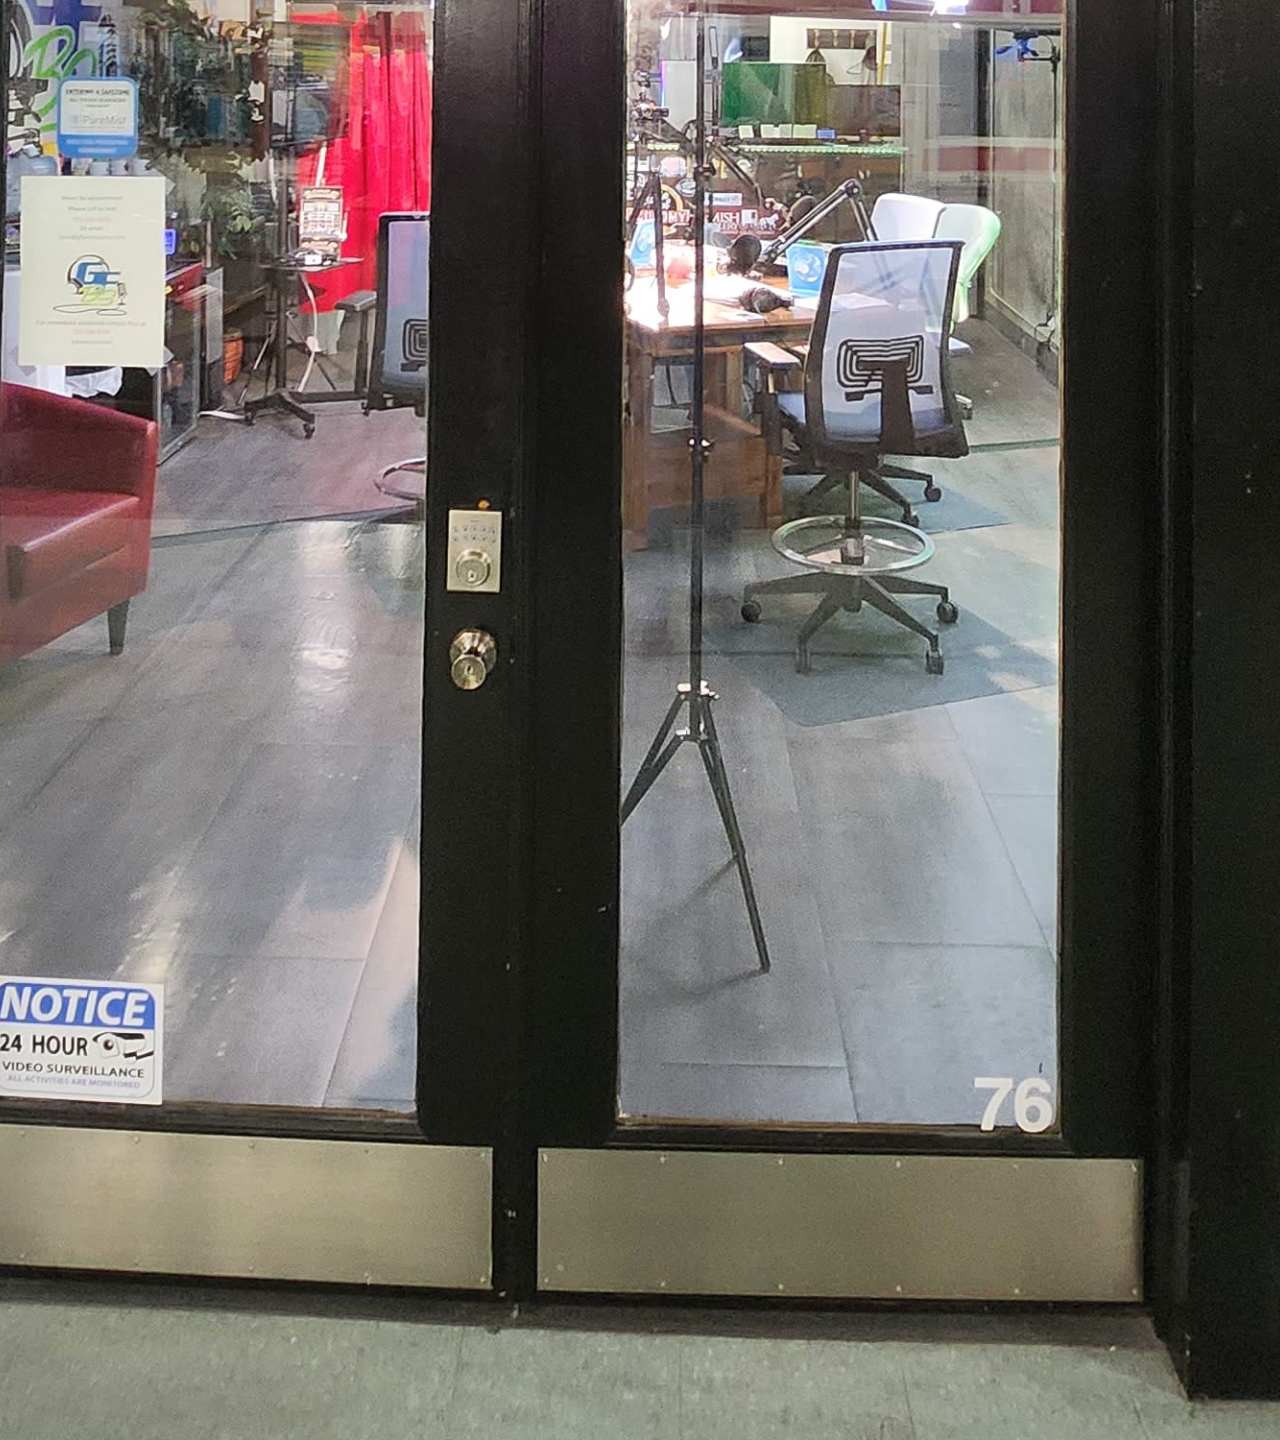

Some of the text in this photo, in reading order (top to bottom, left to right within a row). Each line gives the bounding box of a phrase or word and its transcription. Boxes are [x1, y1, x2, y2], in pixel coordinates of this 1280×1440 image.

[0, 985, 150, 1027] NOTICE
[0, 1033, 88, 1056] 24 HOUR
[2, 1061, 144, 1078] VIDEO SURVEILLANCE
[974, 1077, 1053, 1133] 76
